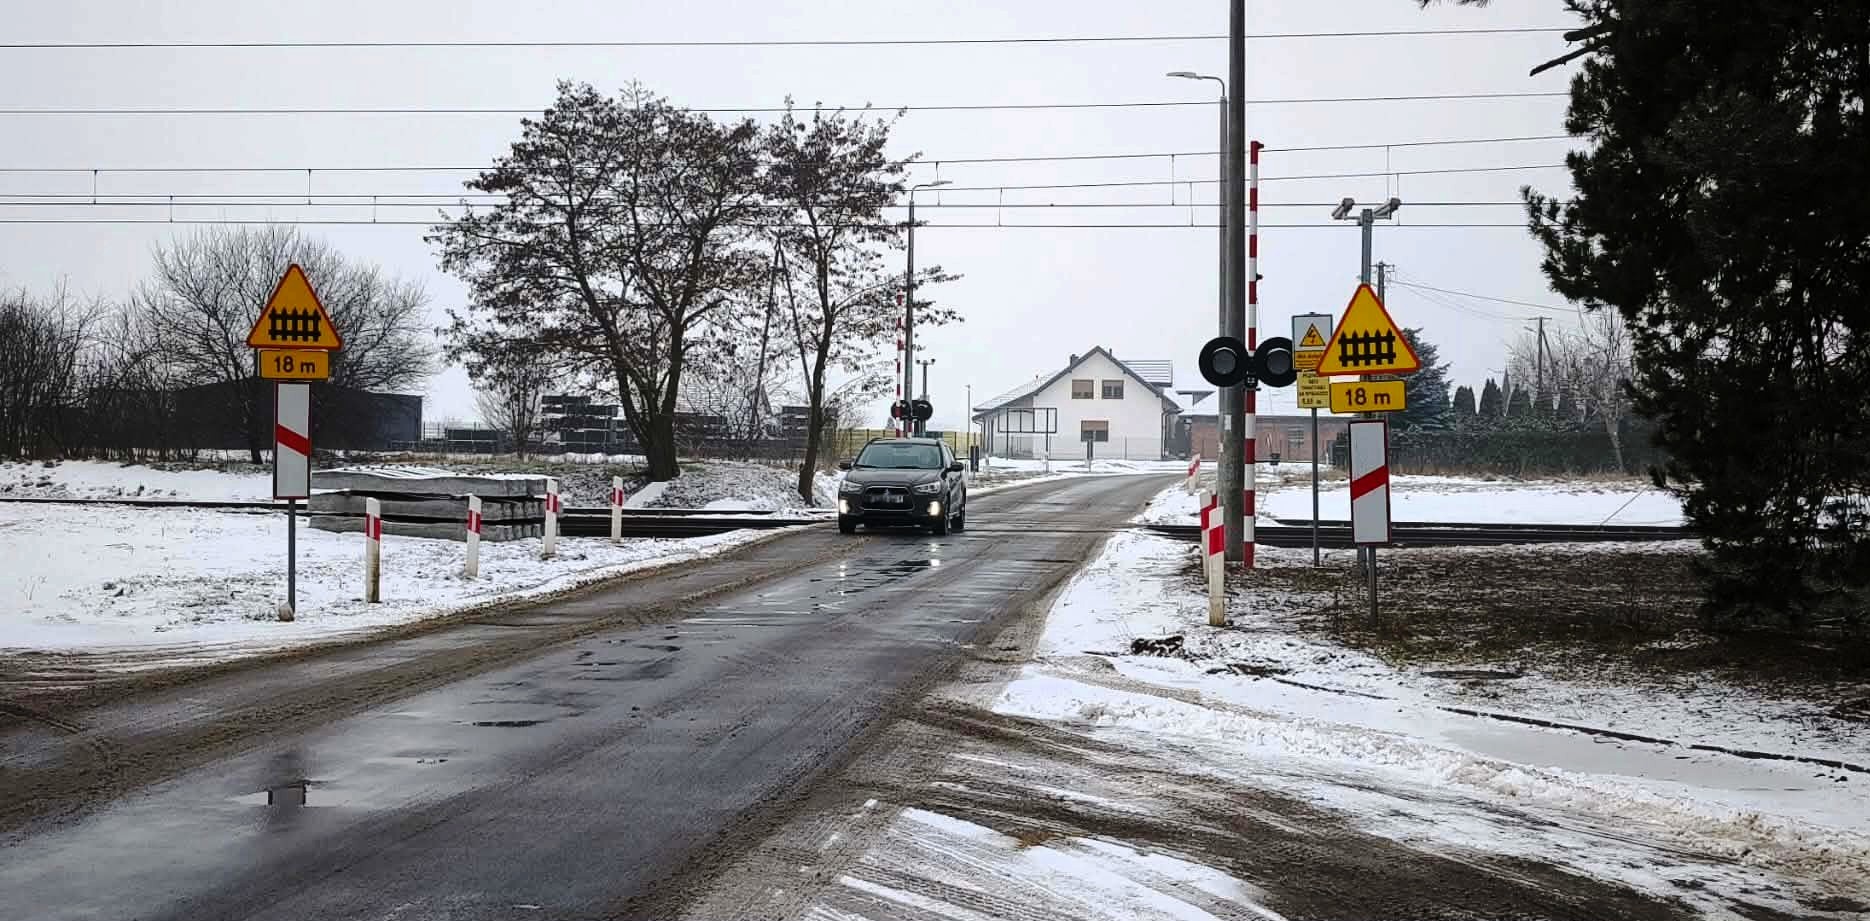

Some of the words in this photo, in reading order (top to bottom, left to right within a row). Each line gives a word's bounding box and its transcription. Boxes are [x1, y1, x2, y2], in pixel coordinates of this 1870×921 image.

[274, 355, 294, 373] 18
[300, 361, 316, 373] m
[1345, 387, 1367, 406] 18
[1374, 392, 1391, 405] m
